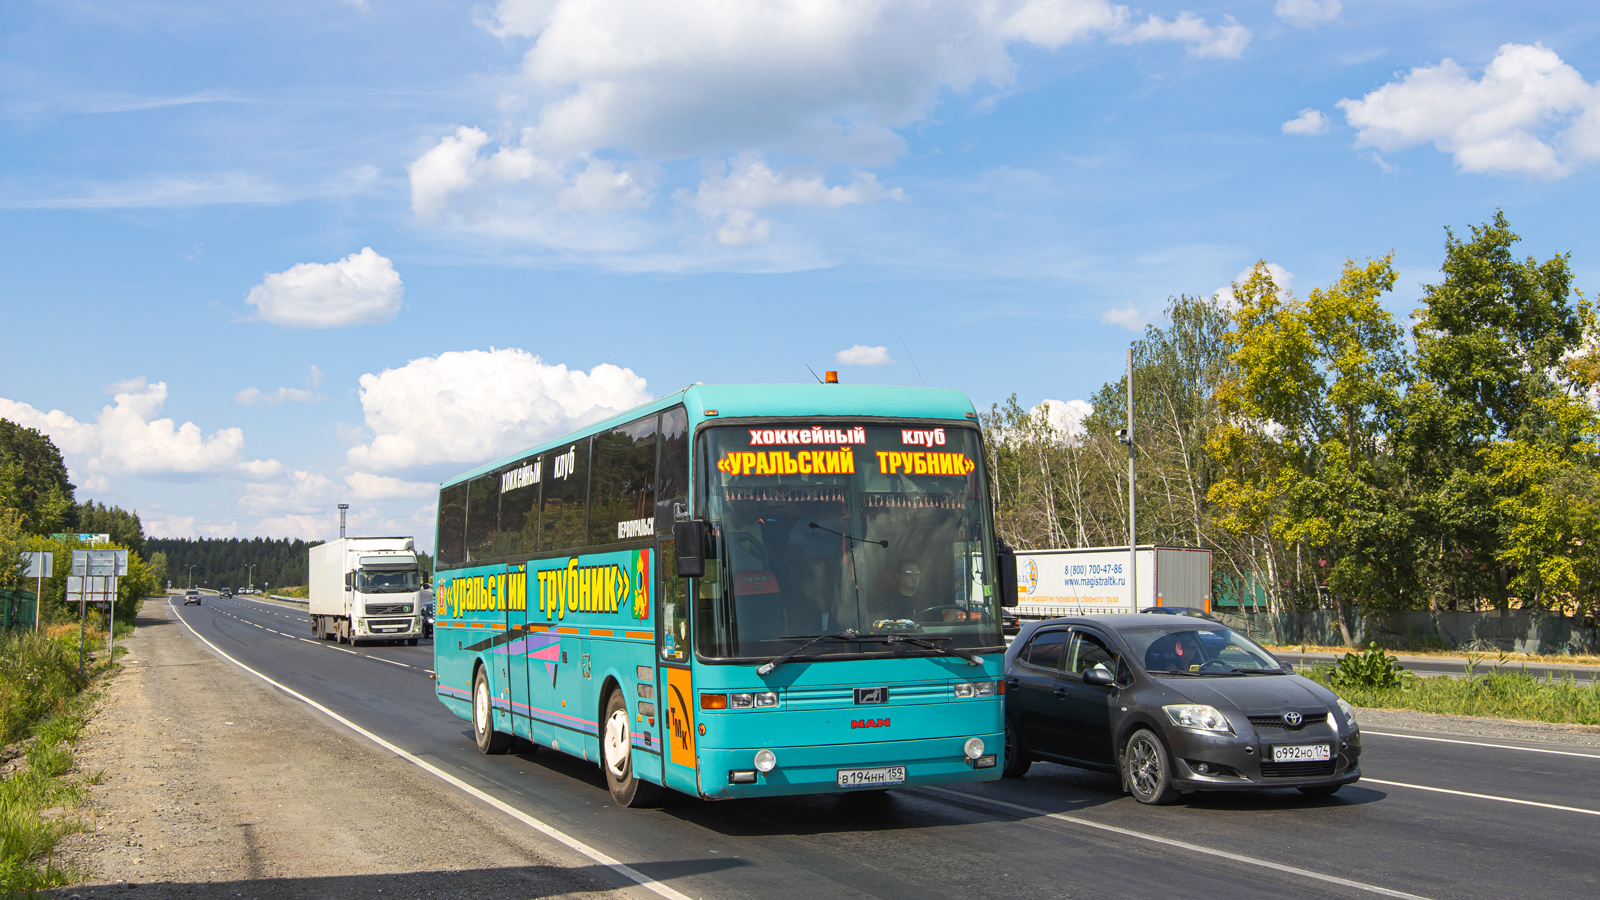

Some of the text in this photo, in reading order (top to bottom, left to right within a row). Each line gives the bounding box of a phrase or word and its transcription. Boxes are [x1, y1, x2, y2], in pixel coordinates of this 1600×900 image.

[749, 426, 946, 447] хоккейный клуб
[717, 446, 975, 476] «УРАЛЬСКИЙ ТРУБНИК»
[501, 445, 575, 493] хоккейный клуб
[1070, 564, 1087, 577] (800)
[1089, 563, 1123, 575] 700-47-86
[743, 575, 771, 583] MAN
[1064, 576, 1125, 588] www.magistraltk.ru
[446, 564, 527, 619] «уральский
[1081, 595, 1104, 604] сборного
[1105, 596, 1119, 605] груза
[850, 718, 891, 729] MAN
